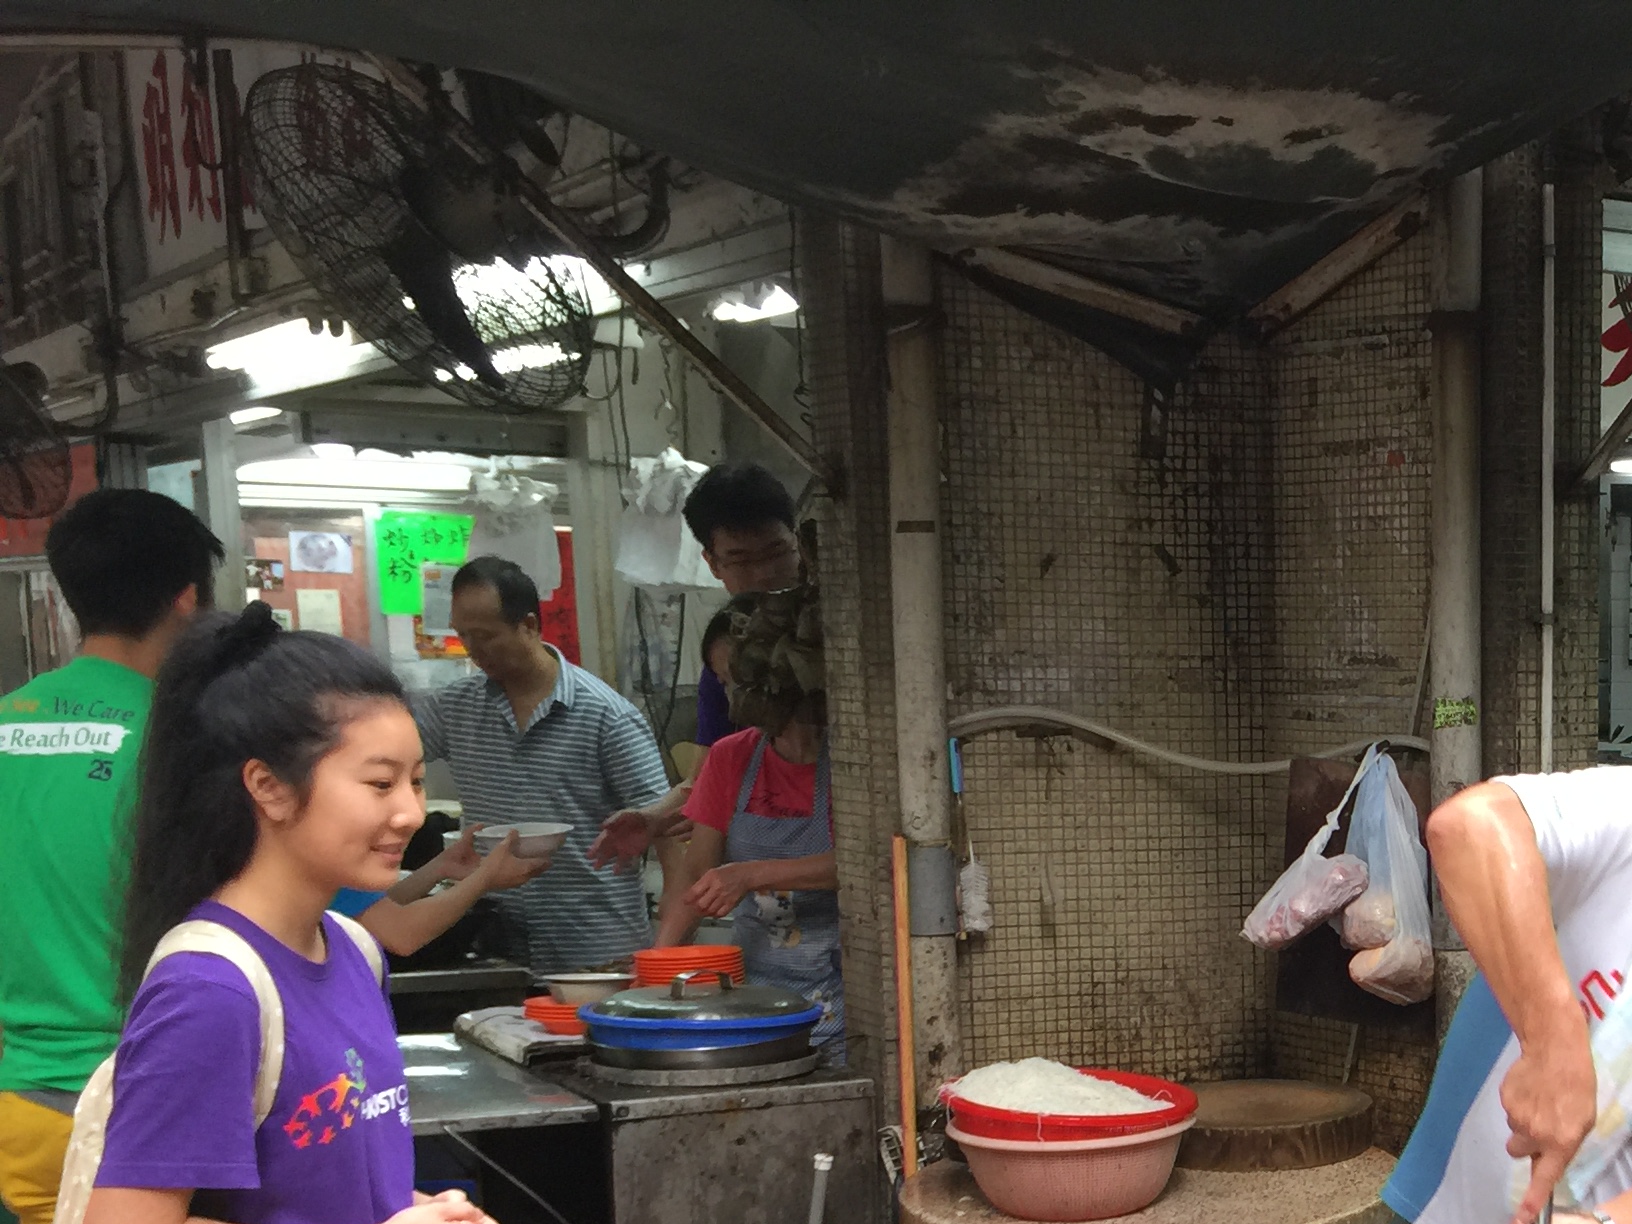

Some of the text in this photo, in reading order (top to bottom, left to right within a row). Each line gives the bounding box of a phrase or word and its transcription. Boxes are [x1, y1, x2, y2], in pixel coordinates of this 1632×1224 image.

[53, 696, 84, 716] We
[88, 700, 135, 721] Care
[10, 727, 70, 748] Reach
[74, 727, 111, 747] Out
